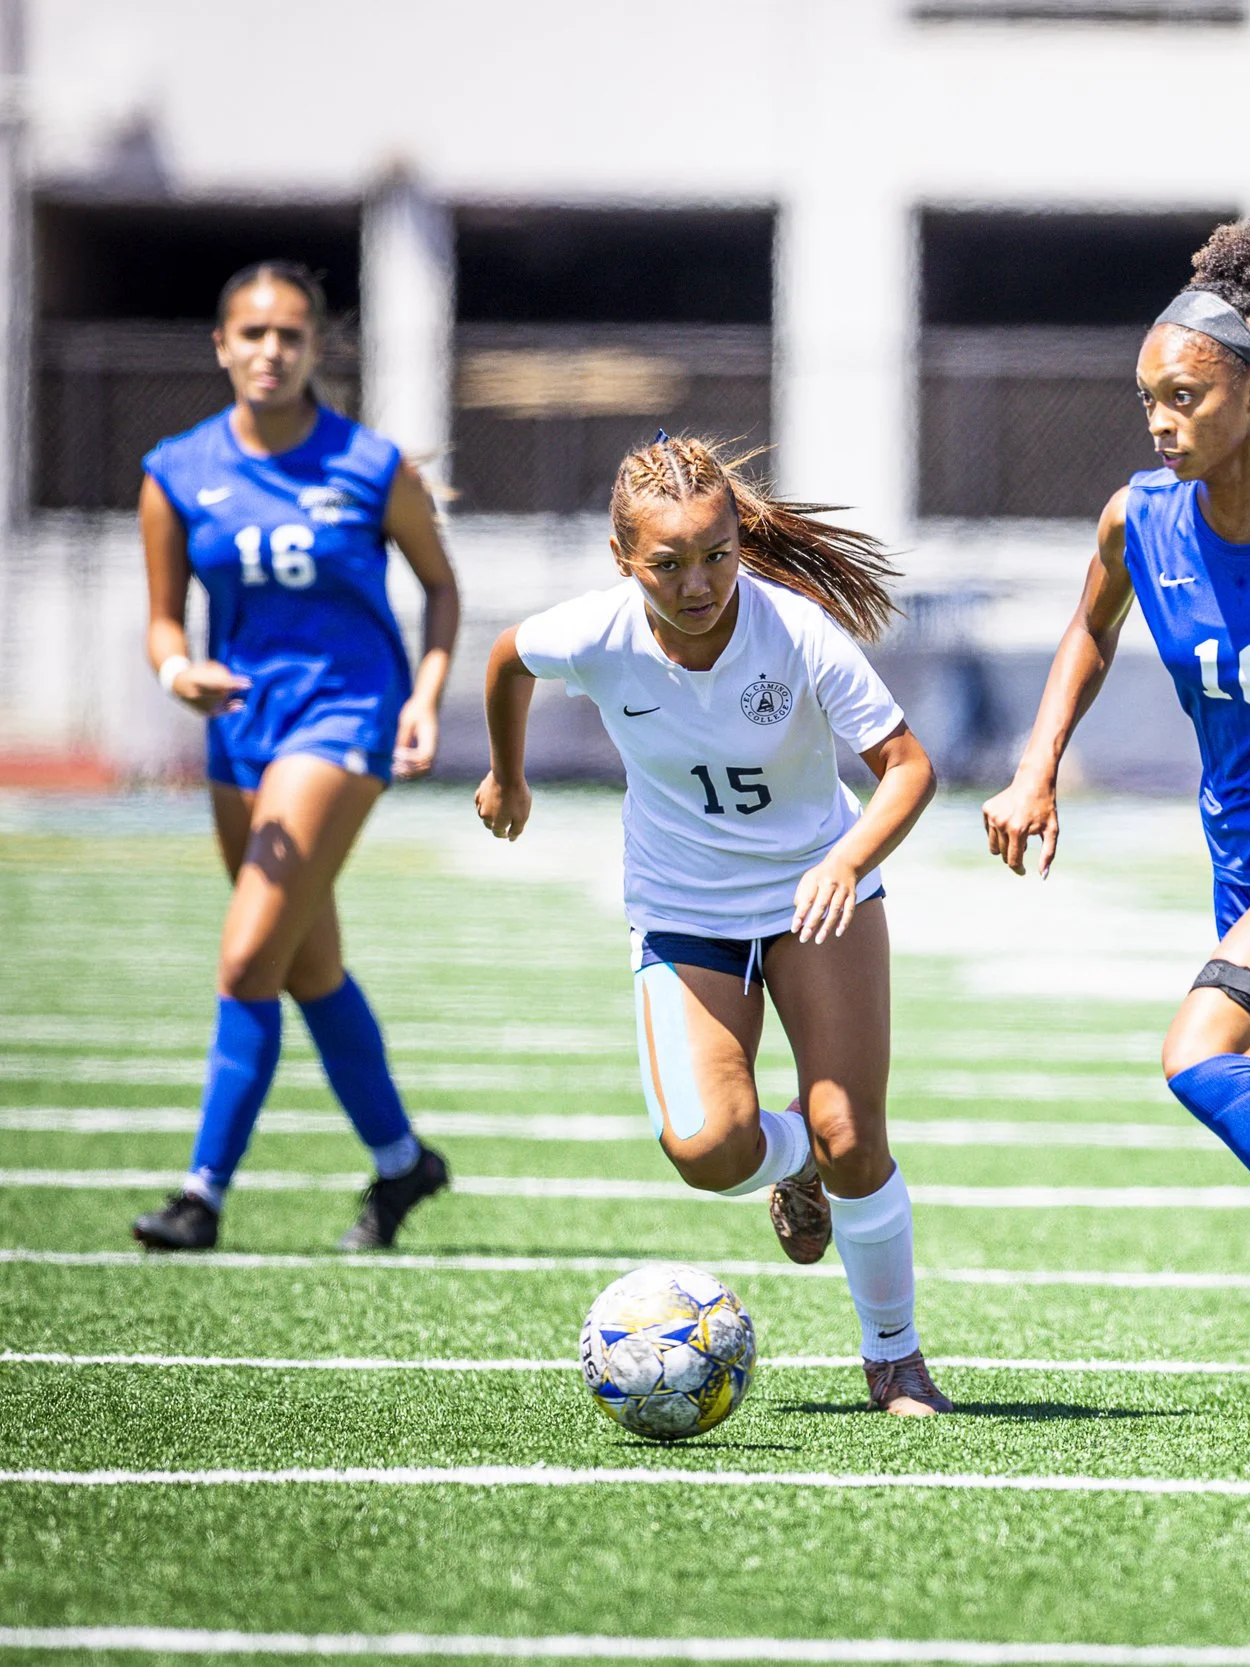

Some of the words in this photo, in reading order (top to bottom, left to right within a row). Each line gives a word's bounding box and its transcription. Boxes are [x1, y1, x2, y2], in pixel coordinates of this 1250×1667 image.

[234, 524, 317, 591] 16
[743, 692, 752, 703] EL
[753, 683, 788, 697] CAMINO
[747, 704, 789, 723] COLLEGE
[690, 765, 772, 815] 15
